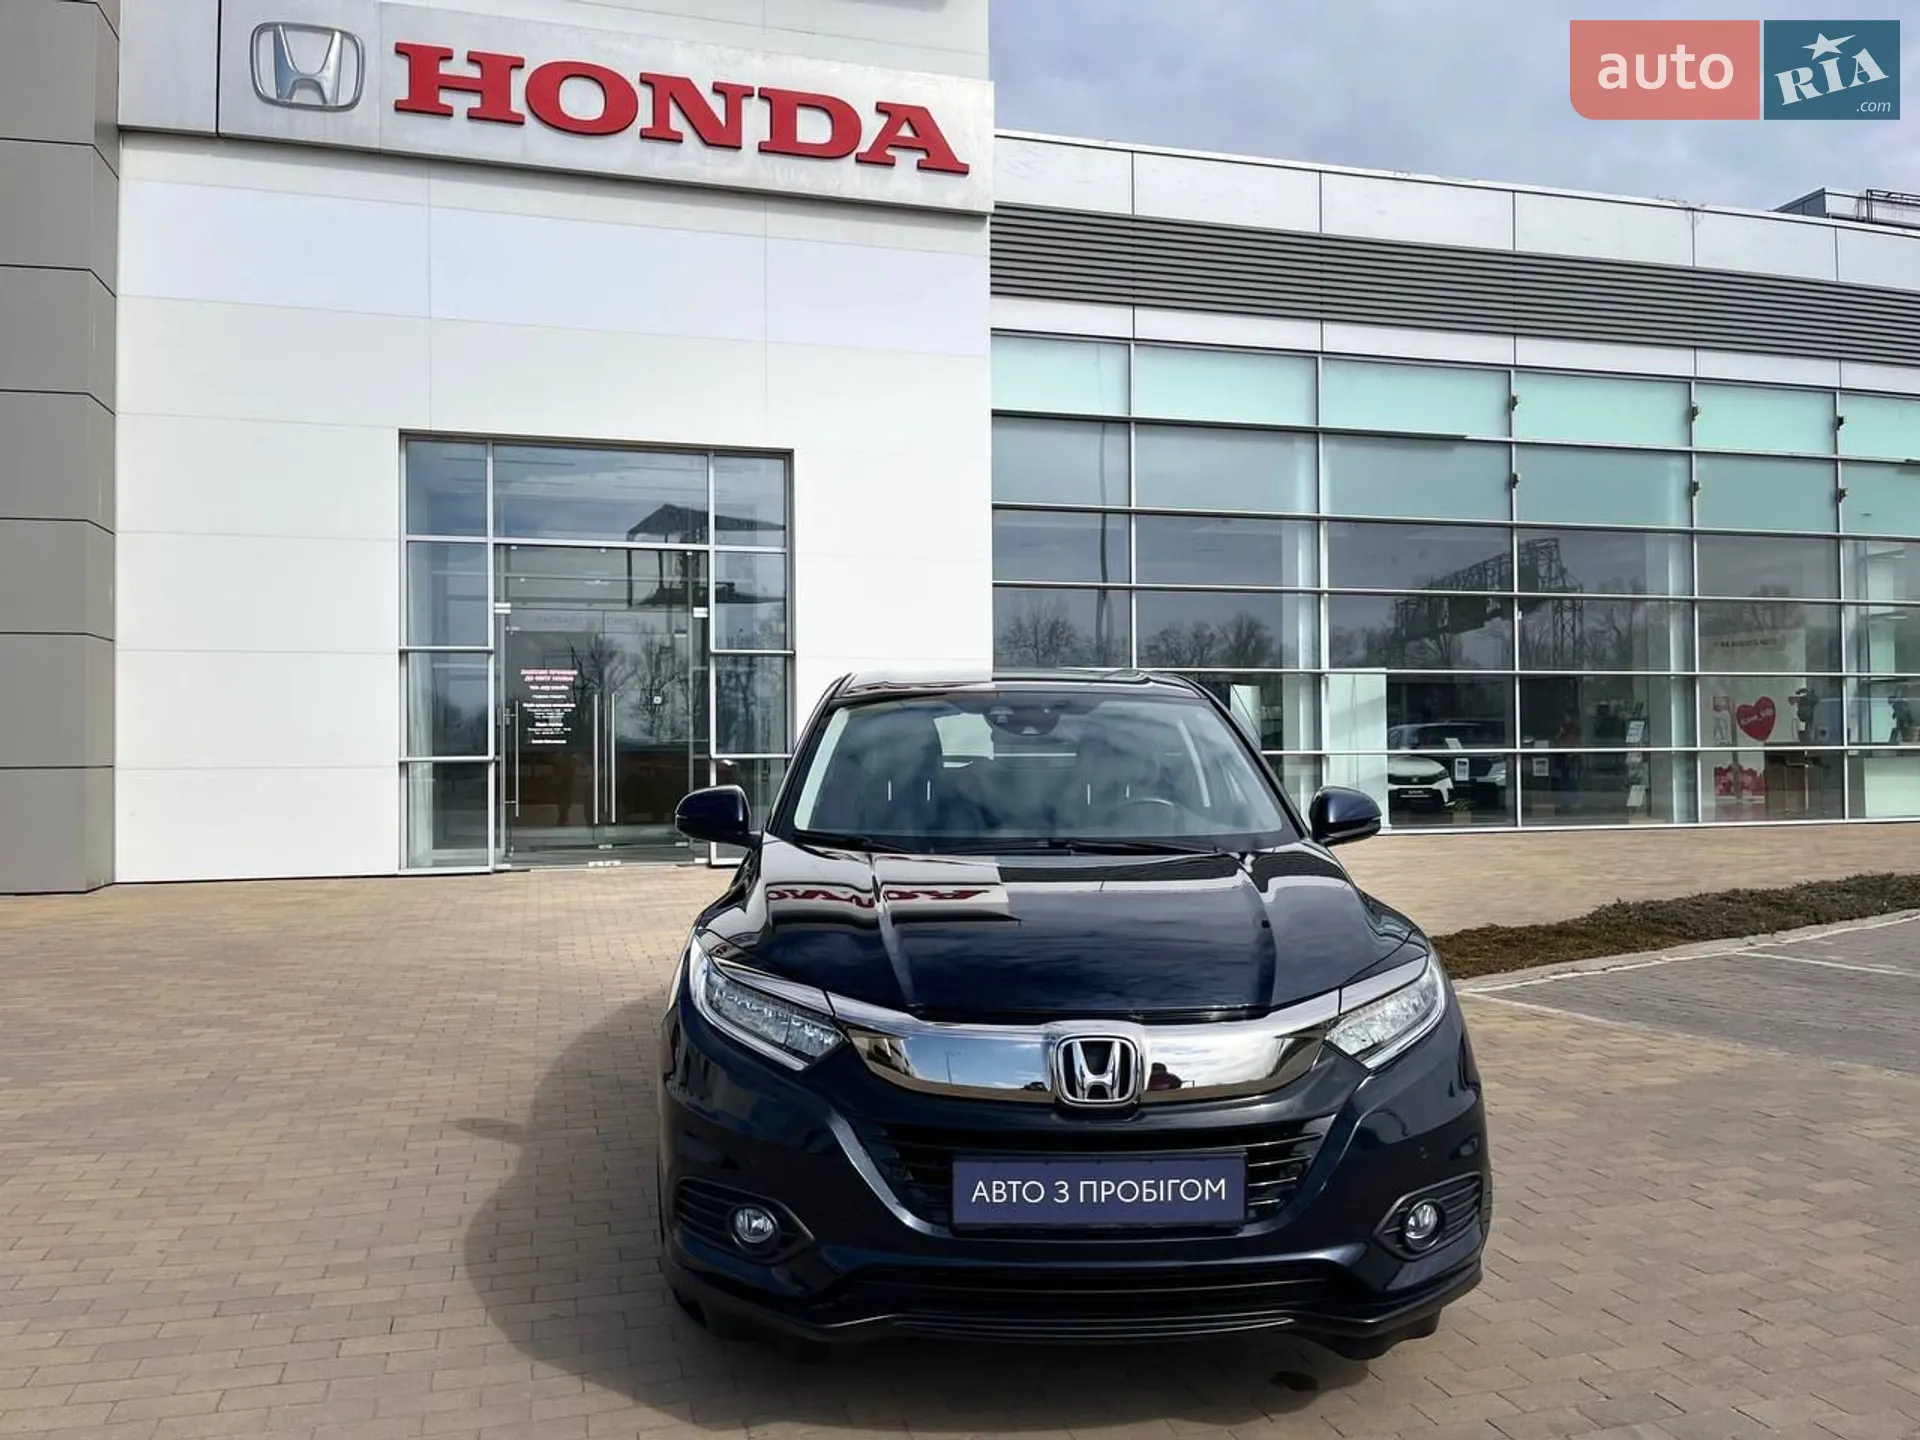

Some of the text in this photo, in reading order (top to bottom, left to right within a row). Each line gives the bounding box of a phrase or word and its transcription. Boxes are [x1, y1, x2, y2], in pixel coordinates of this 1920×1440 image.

[394, 41, 969, 175] HONDA
[972, 1178, 1226, 1203] АВТО З ПРОБІГОМ
